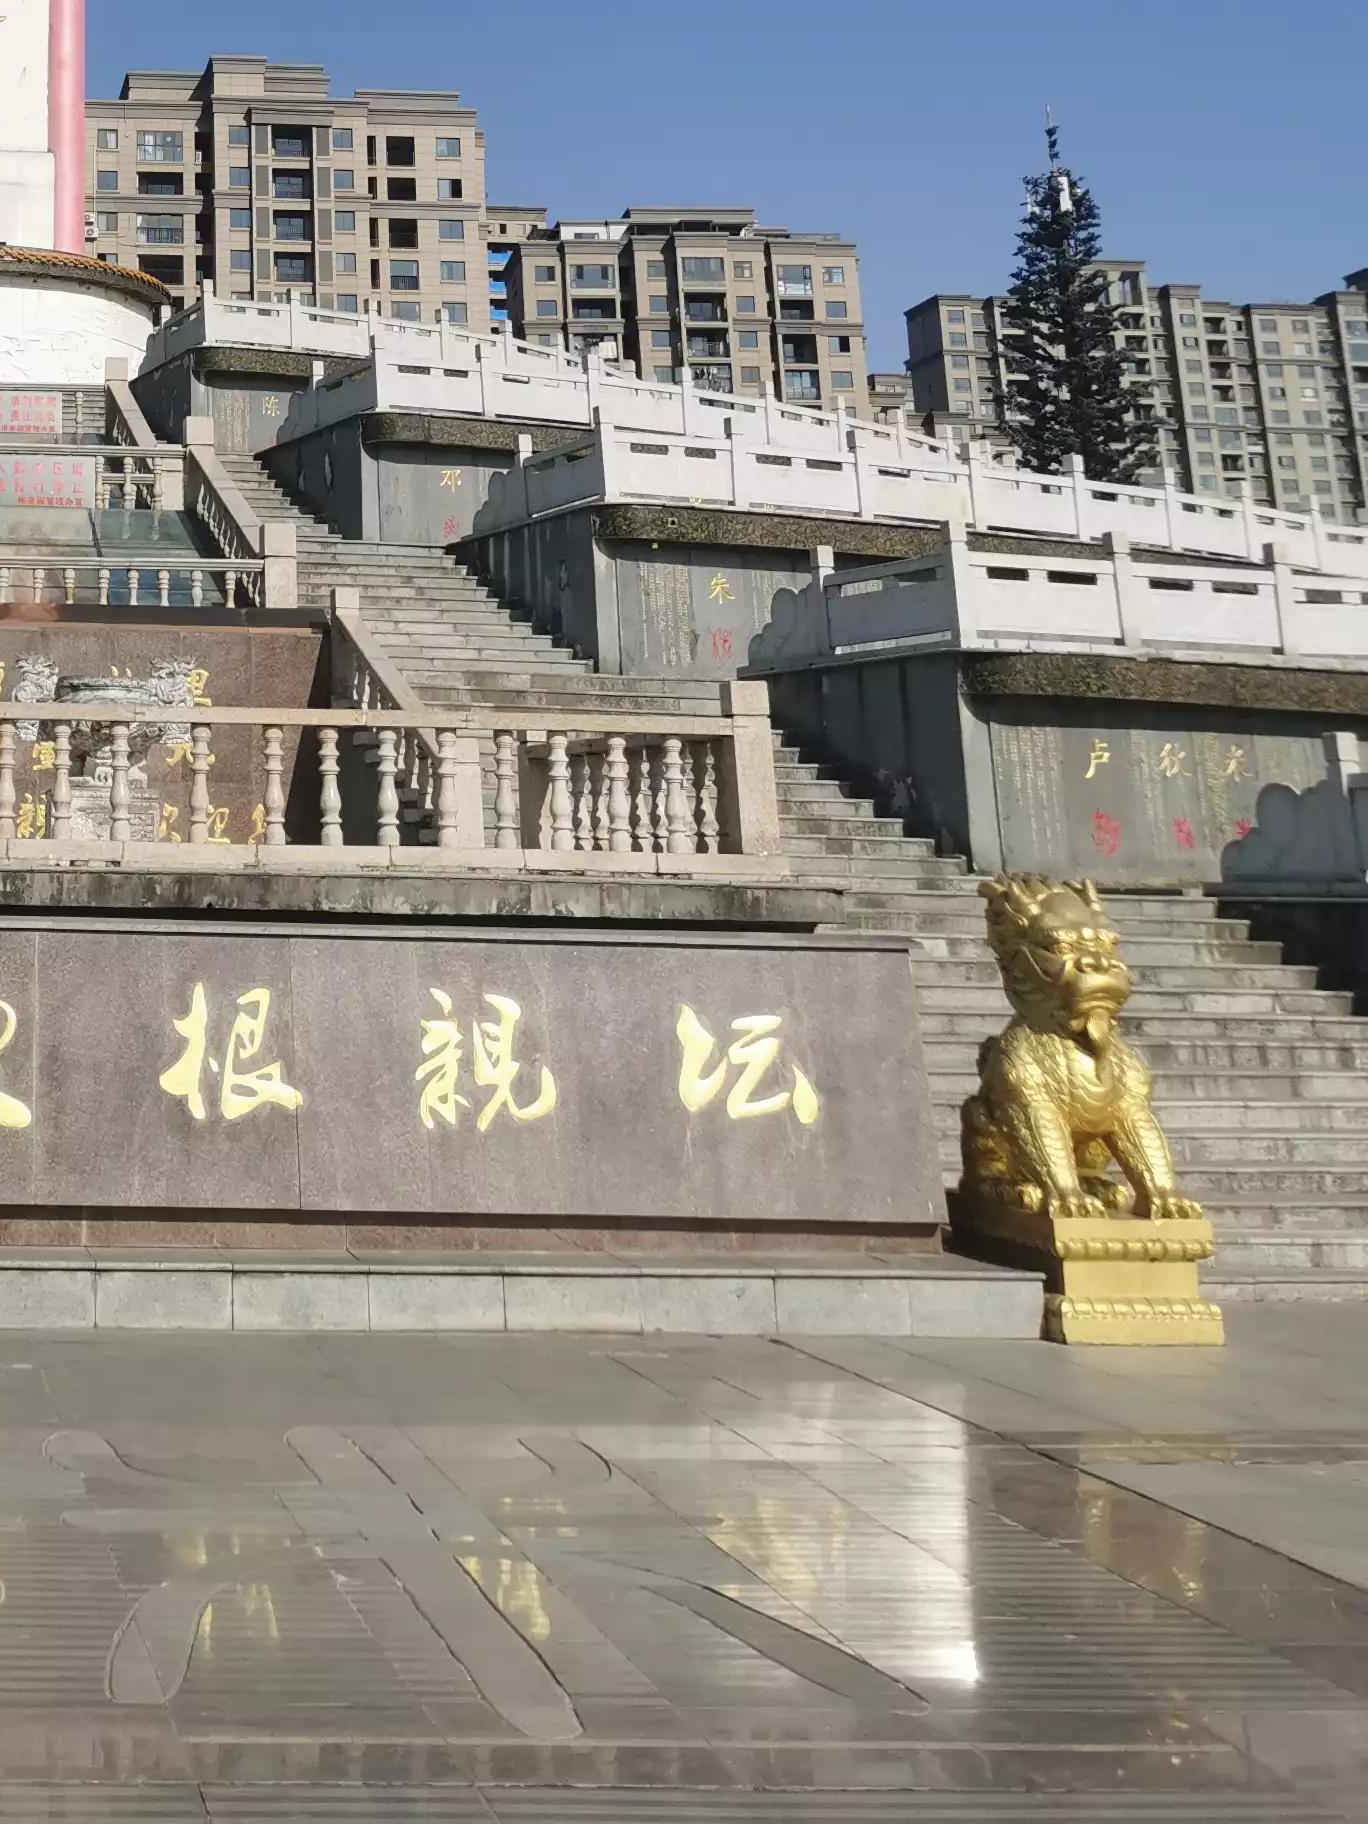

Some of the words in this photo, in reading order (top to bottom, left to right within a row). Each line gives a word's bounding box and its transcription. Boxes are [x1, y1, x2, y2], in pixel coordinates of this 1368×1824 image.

[262, 395, 280, 417] 陈
[440, 469, 462, 494] 邓
[708, 571, 736, 605] 朱
[1084, 738, 1111, 779] 卢
